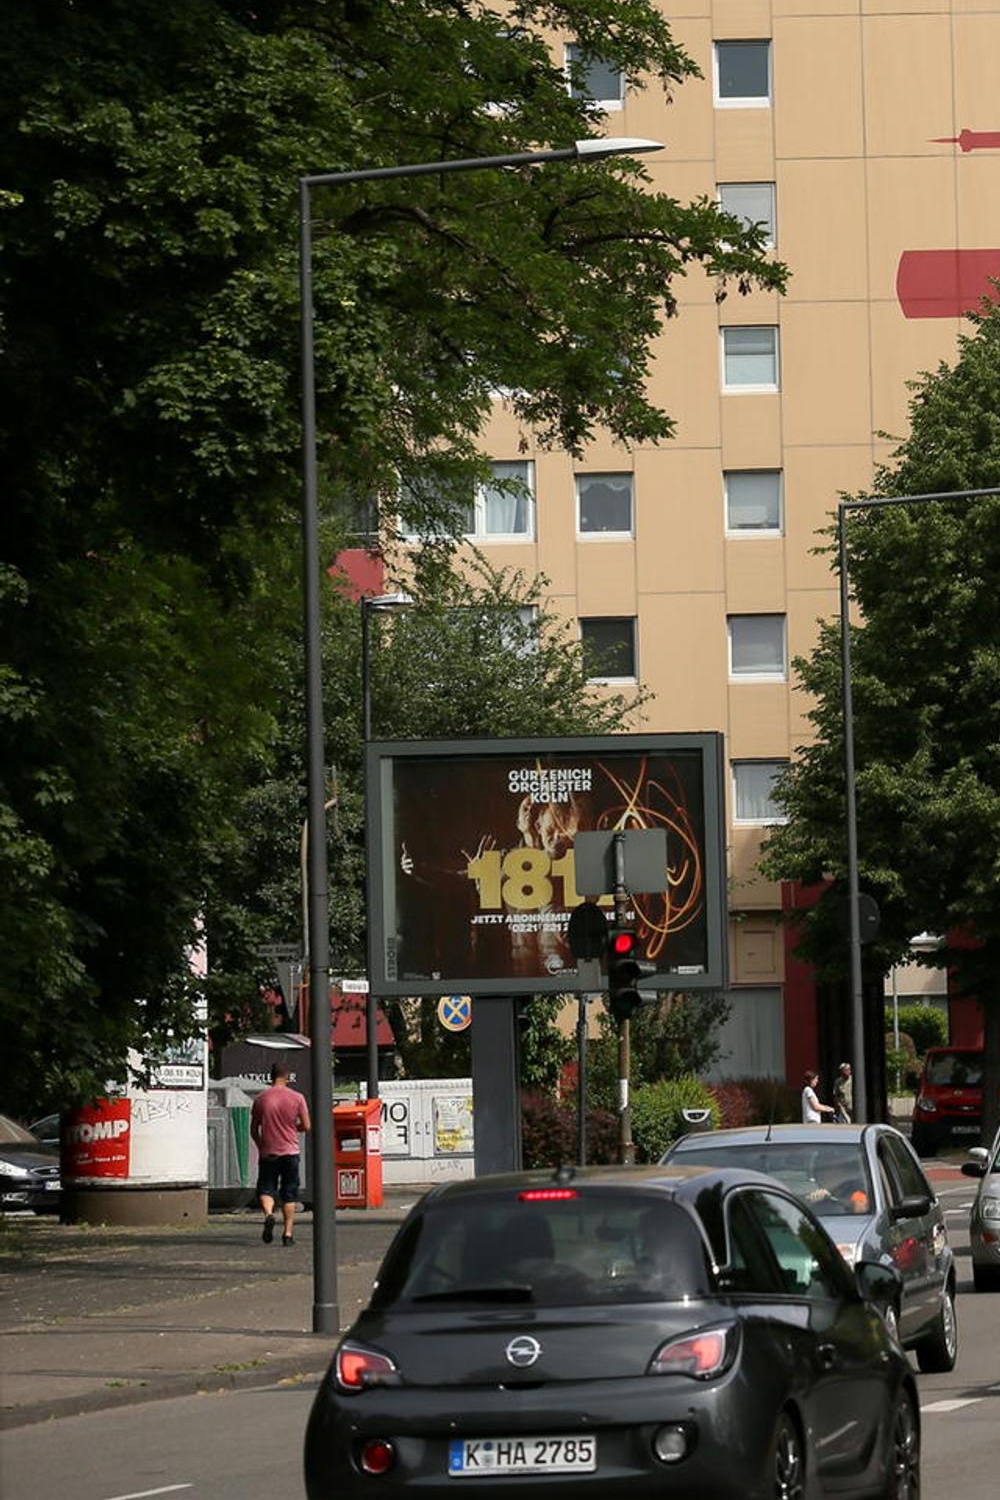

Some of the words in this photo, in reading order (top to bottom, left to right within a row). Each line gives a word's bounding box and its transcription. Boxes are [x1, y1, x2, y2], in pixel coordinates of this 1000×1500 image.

[507, 768, 592, 781] GÜRZENICH
[508, 780, 592, 793] ORCHESTER
[467, 847, 615, 910] 181
[470, 915, 504, 925] JETZT
[466, 1443, 480, 1467] K
[496, 1441, 527, 1466] HA
[534, 1439, 592, 1464] 2785
